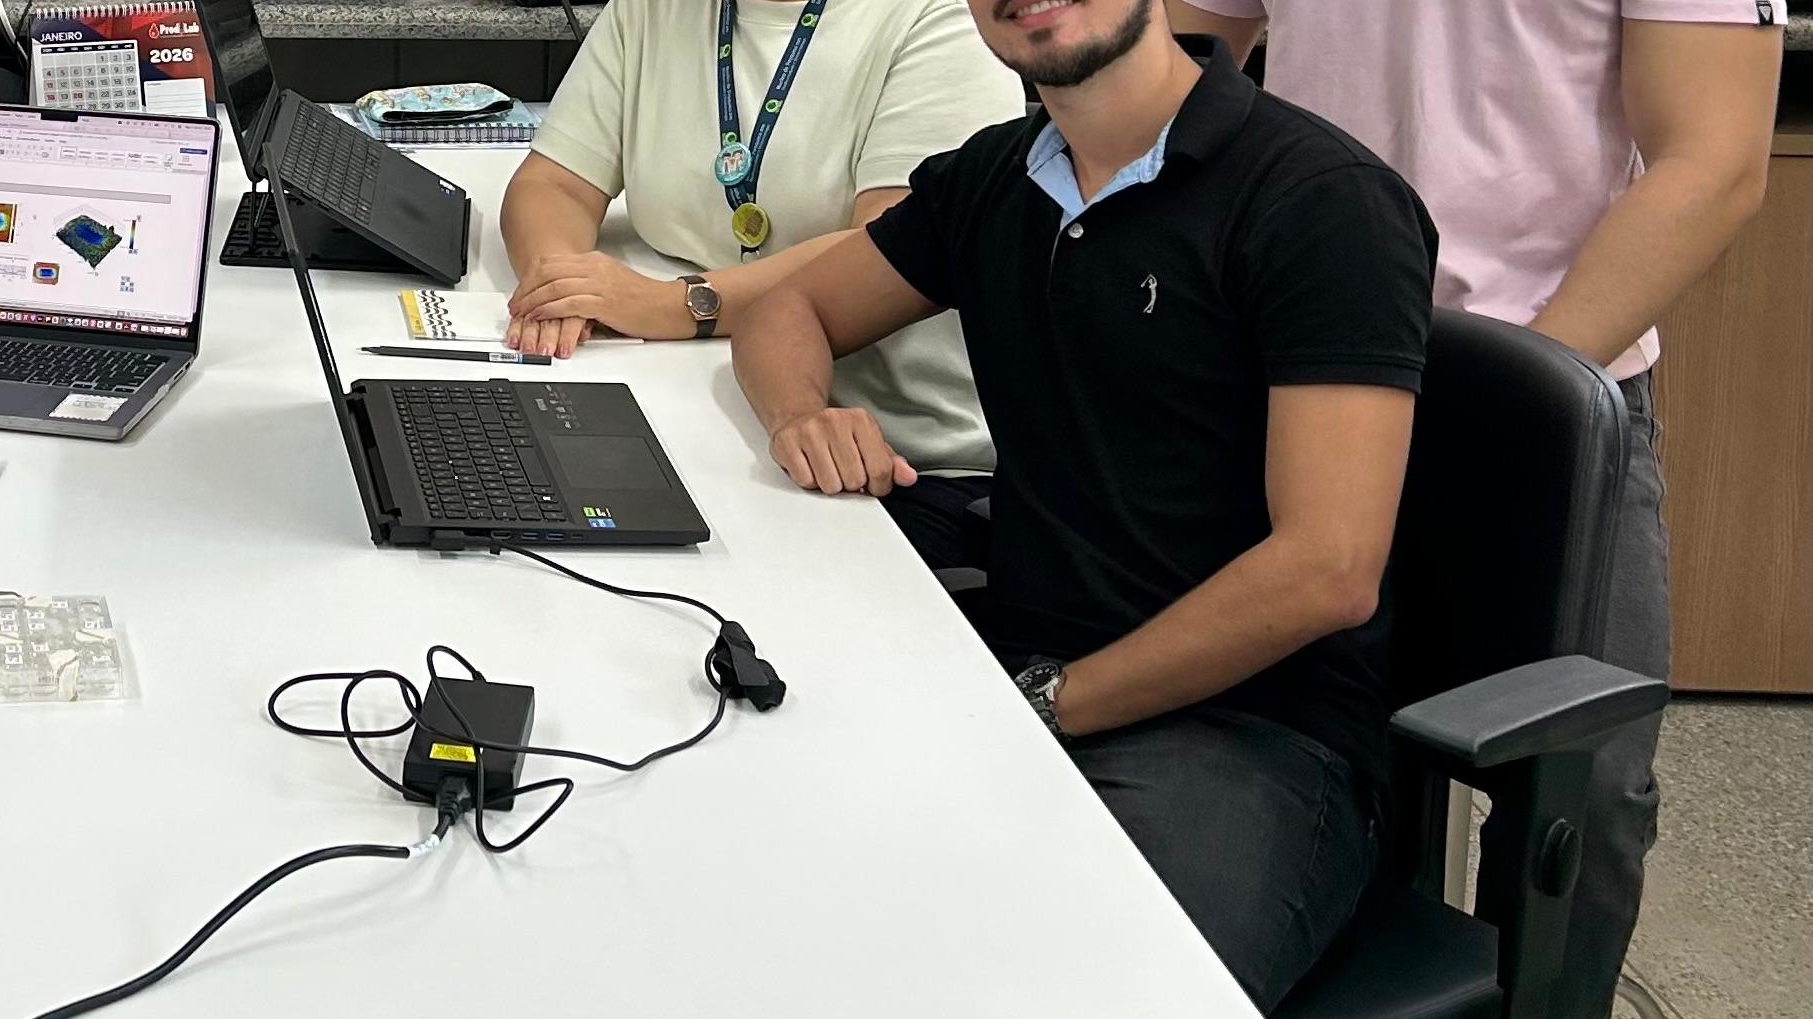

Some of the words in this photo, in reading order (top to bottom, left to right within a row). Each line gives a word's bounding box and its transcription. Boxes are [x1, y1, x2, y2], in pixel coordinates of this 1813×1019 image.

[40, 31, 83, 43] JANEIRO
[149, 47, 194, 64] 2026
[126, 65, 134, 73] 10
[114, 101, 124, 109] 30
